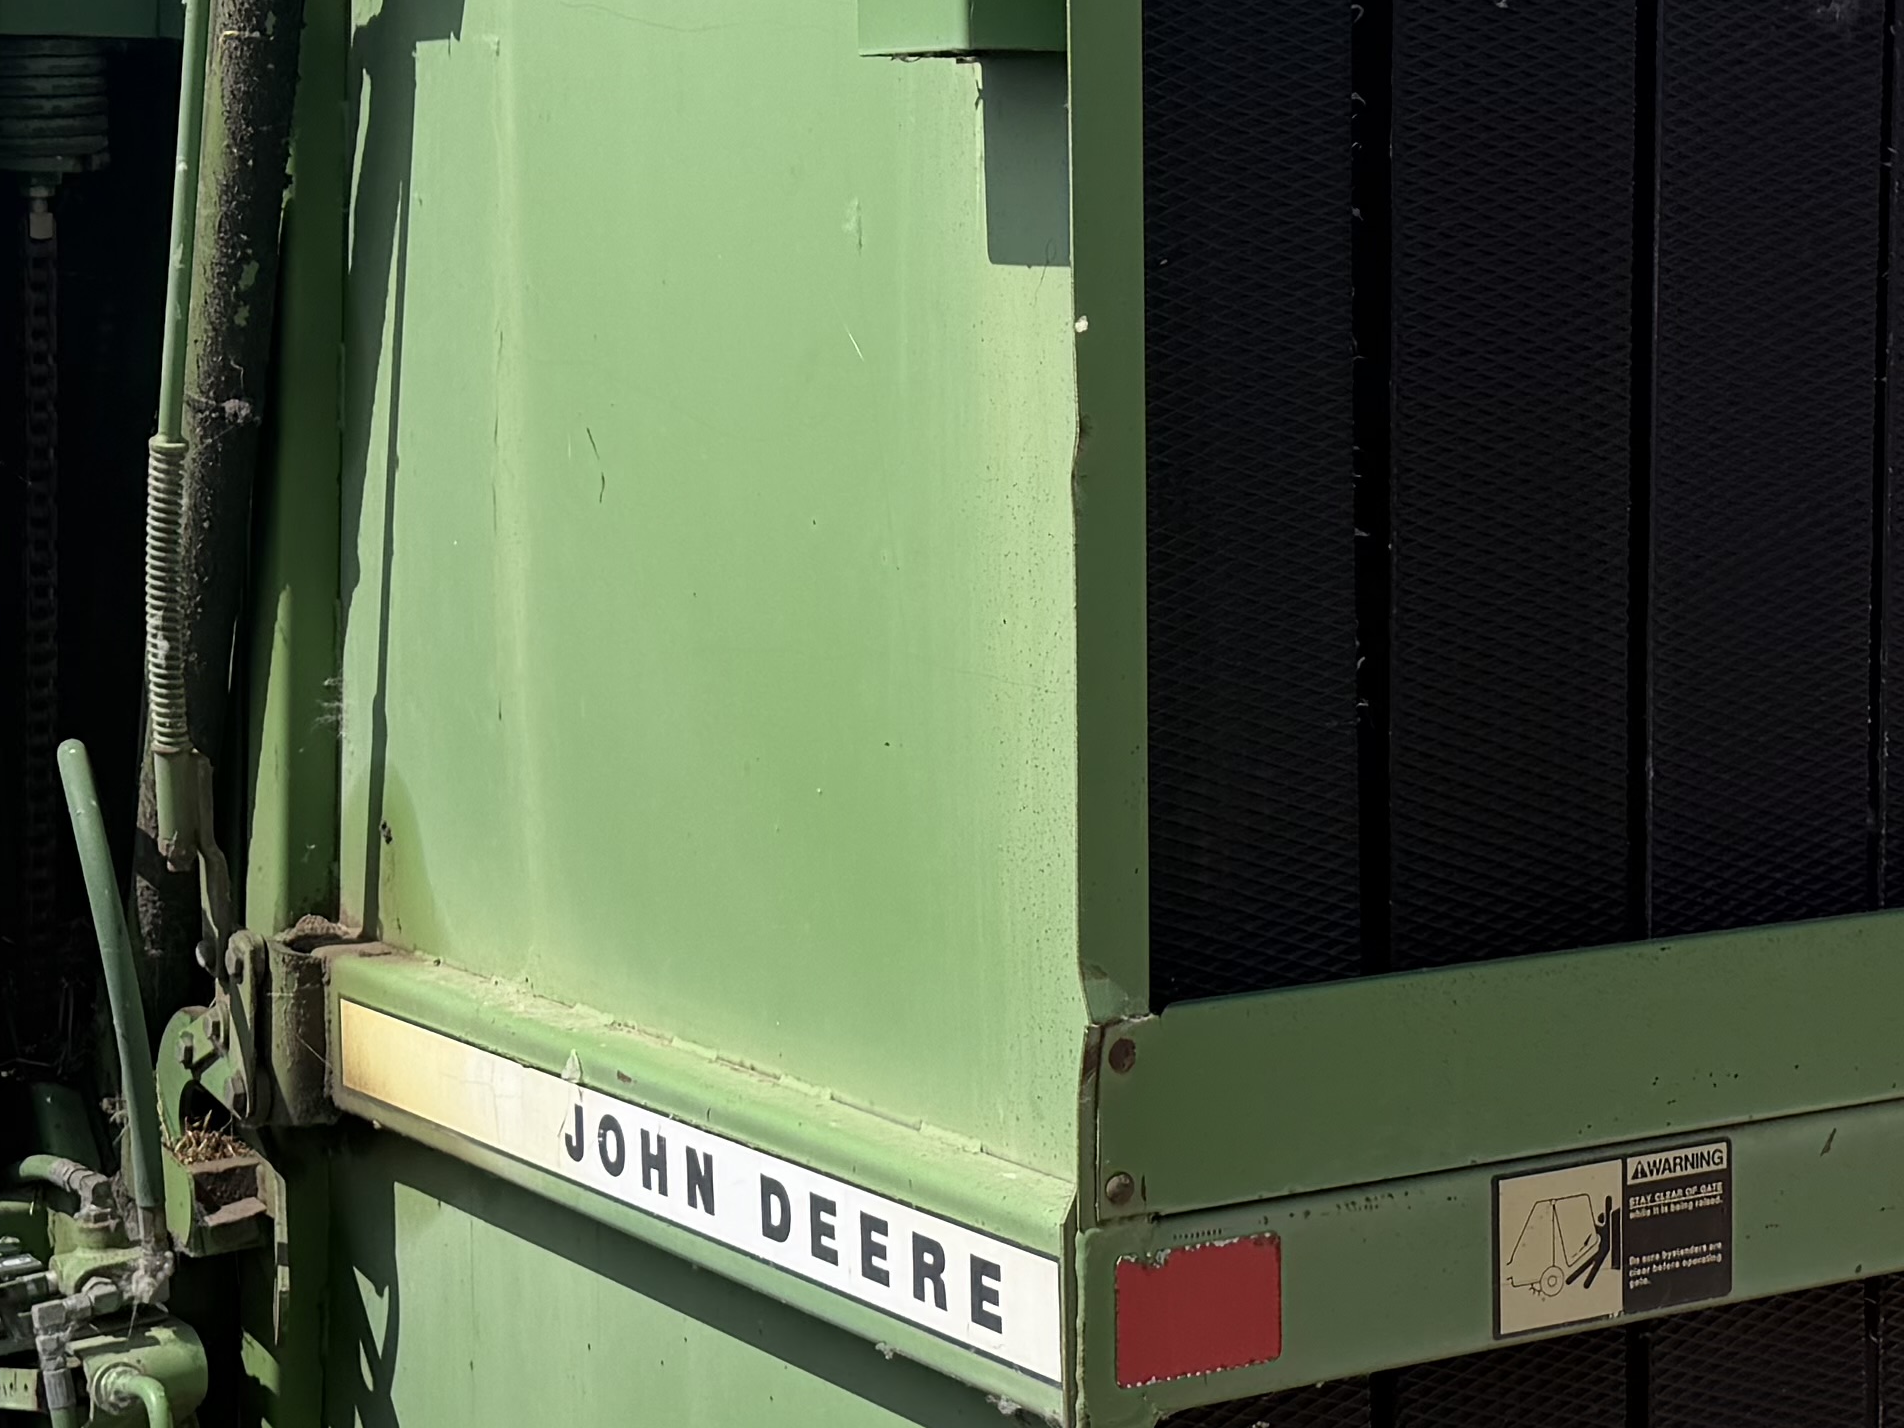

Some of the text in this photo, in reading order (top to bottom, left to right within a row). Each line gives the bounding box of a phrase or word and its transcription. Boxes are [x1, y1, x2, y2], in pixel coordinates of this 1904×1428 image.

[1647, 1148, 1724, 1177] WARNING
[1629, 1181, 1723, 1207] STAY CLEAR OF GATE
[564, 1103, 1004, 1335] JOHN DEERE
[1629, 1208, 1651, 1220] while
[1670, 1200, 1694, 1211] being
[1661, 1244, 1707, 1259] bystanders
[1629, 1253, 1723, 1277] clear before operating
